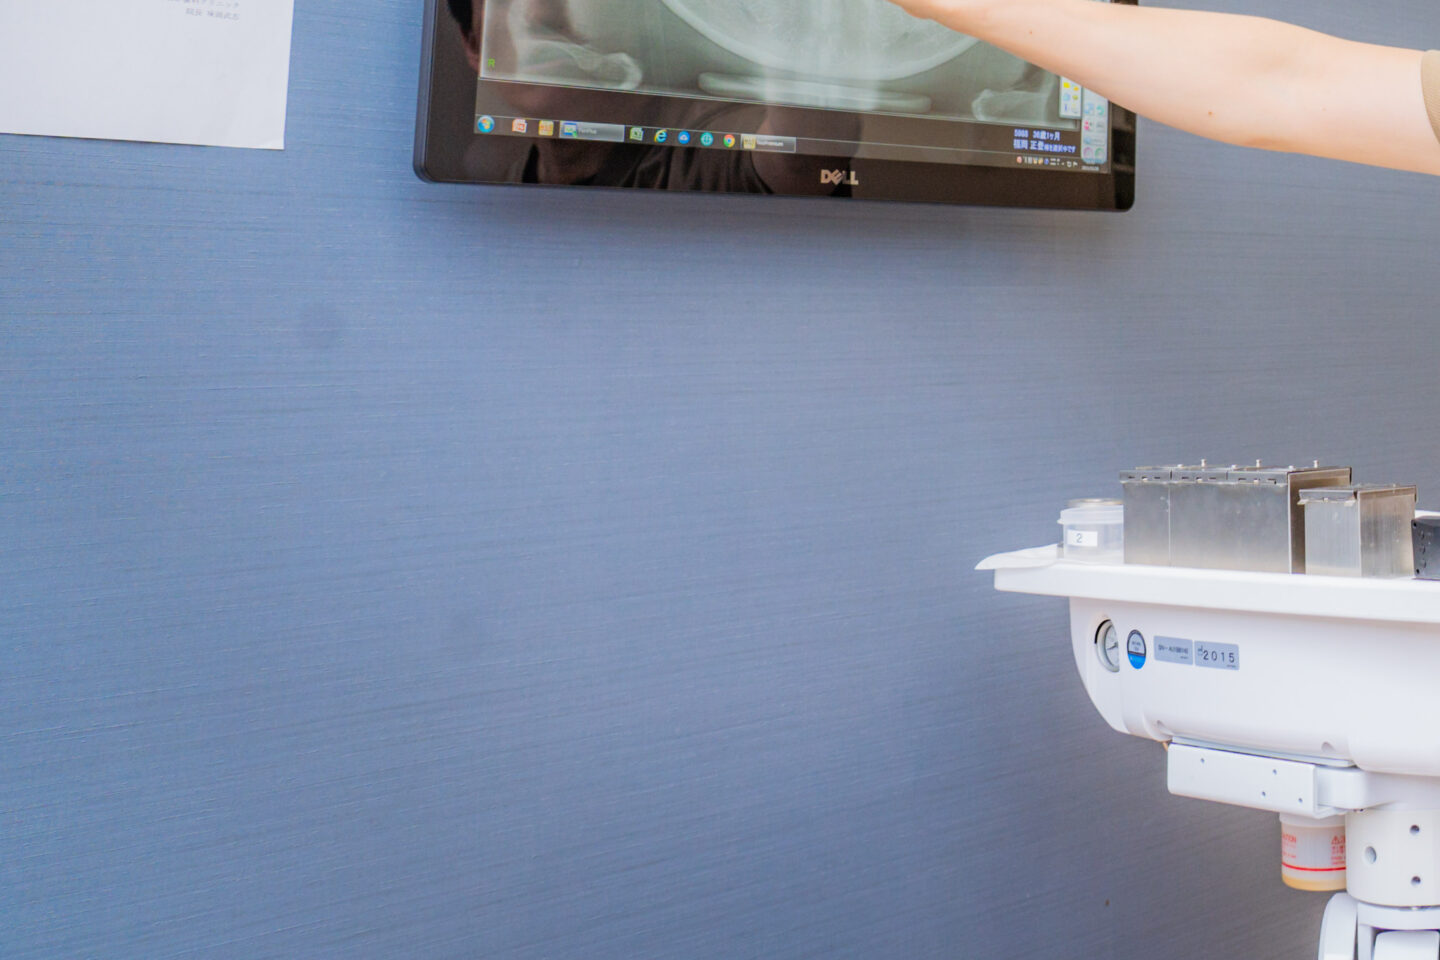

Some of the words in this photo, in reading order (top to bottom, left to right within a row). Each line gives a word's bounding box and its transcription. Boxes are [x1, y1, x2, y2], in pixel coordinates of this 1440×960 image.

[820, 169, 859, 185] DELL
[1076, 532, 1083, 544] 2
[1203, 649, 1235, 664] 2015
